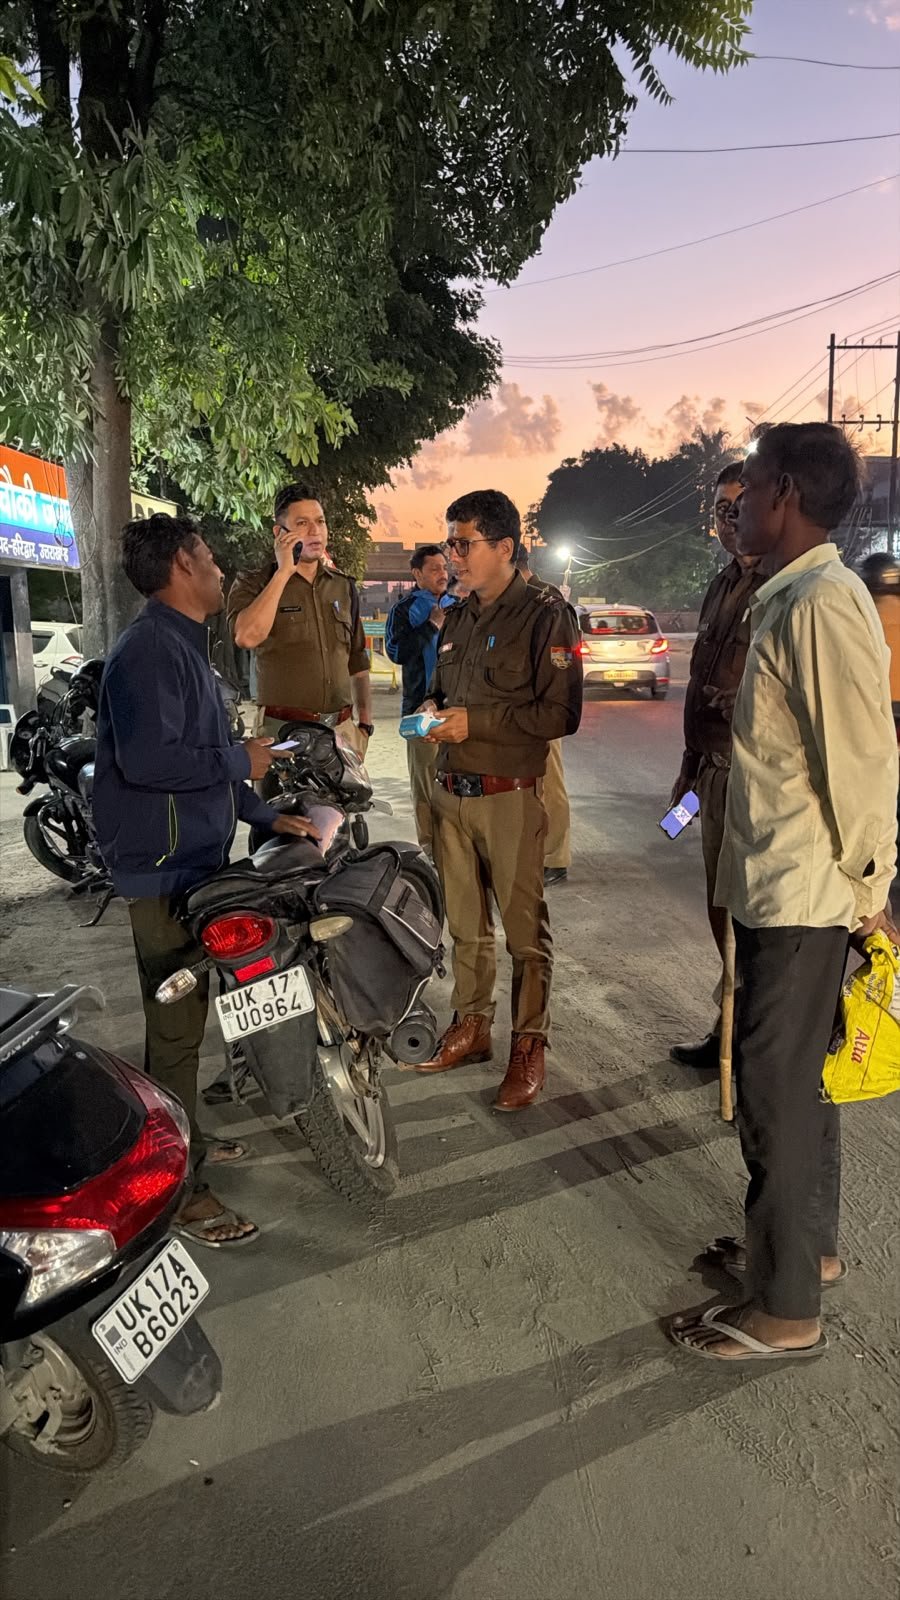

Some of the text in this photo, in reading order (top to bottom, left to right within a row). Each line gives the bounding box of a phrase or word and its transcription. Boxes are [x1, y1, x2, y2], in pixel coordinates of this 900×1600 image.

[231, 973, 289, 1011] UK 17
[236, 991, 302, 1031] U0964
[851, 1027, 871, 1065] Atta
[132, 1275, 199, 1359] B6023
[114, 1338, 128, 1355] IND
